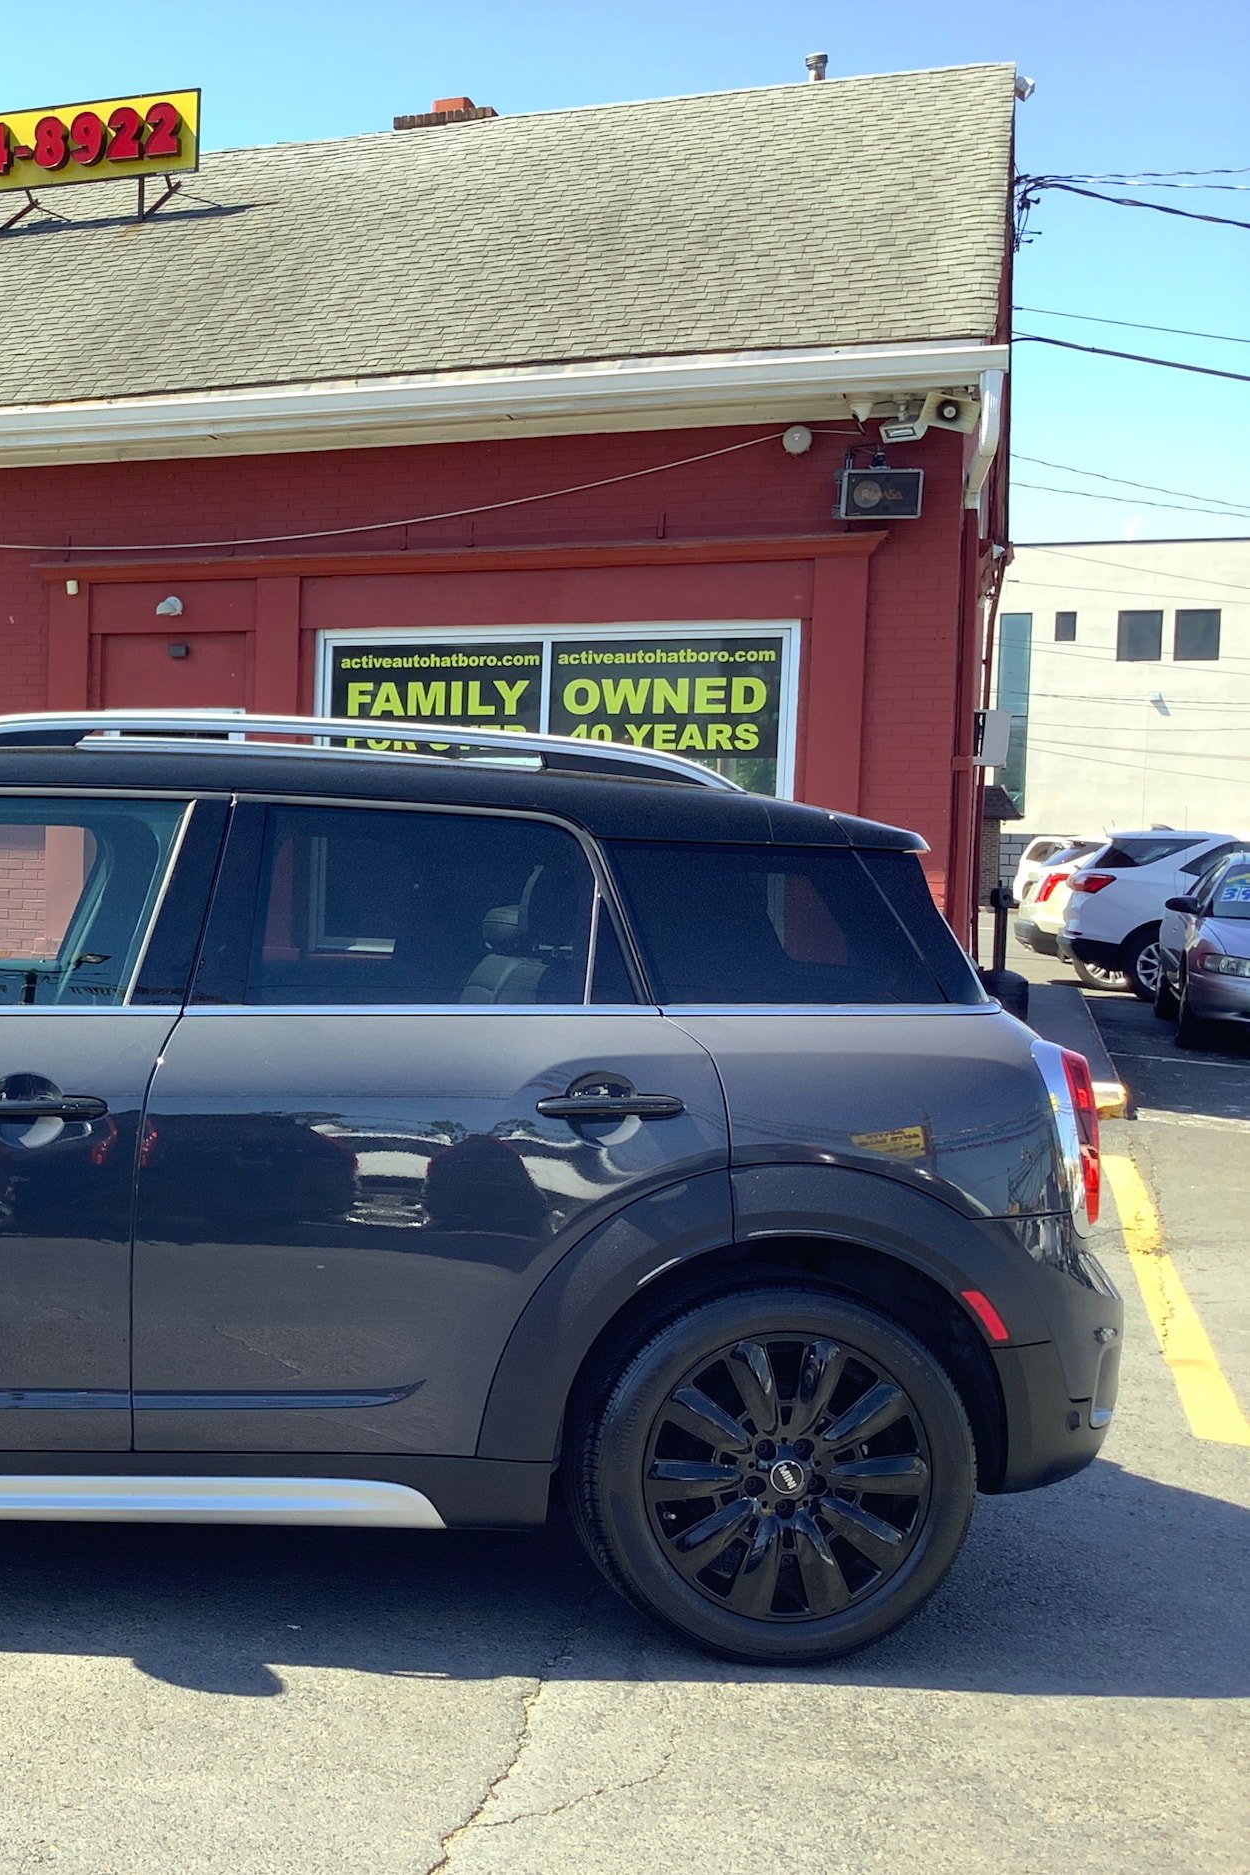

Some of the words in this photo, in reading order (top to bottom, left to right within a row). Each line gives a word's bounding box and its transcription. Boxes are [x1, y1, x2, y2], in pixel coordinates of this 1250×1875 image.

[341, 653, 540, 669] activeautohatboro.com
[558, 649, 776, 665] activeautohatboro.com
[347, 680, 530, 716] FAMILY
[563, 677, 767, 715] OWNED
[625, 723, 759, 751] YEARS
[778, 1464, 797, 1490] MINI
